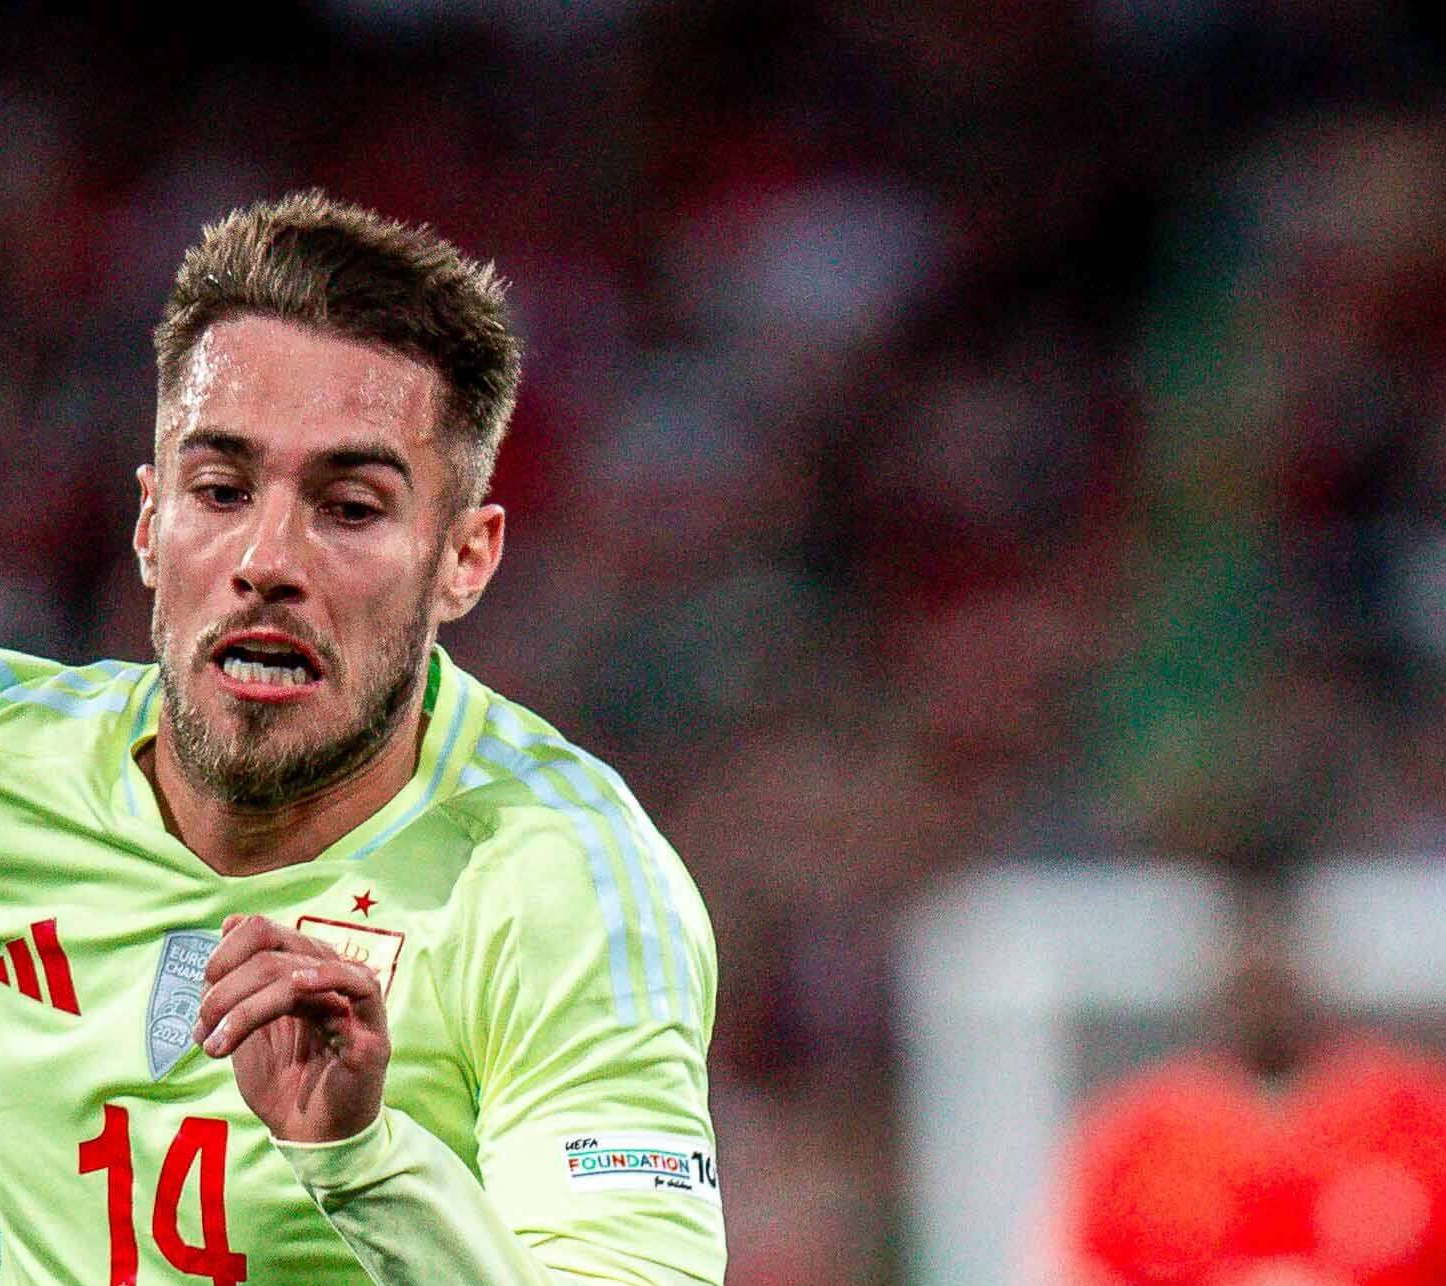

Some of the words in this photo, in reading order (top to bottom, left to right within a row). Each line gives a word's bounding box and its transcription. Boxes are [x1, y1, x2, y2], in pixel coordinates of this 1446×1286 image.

[169, 944, 206, 969] EURO
[166, 961, 204, 982] CHAM
[153, 1025, 188, 1047] 2024
[565, 1138, 598, 1151] UEFA
[568, 1153, 690, 1174] FOUNDATION
